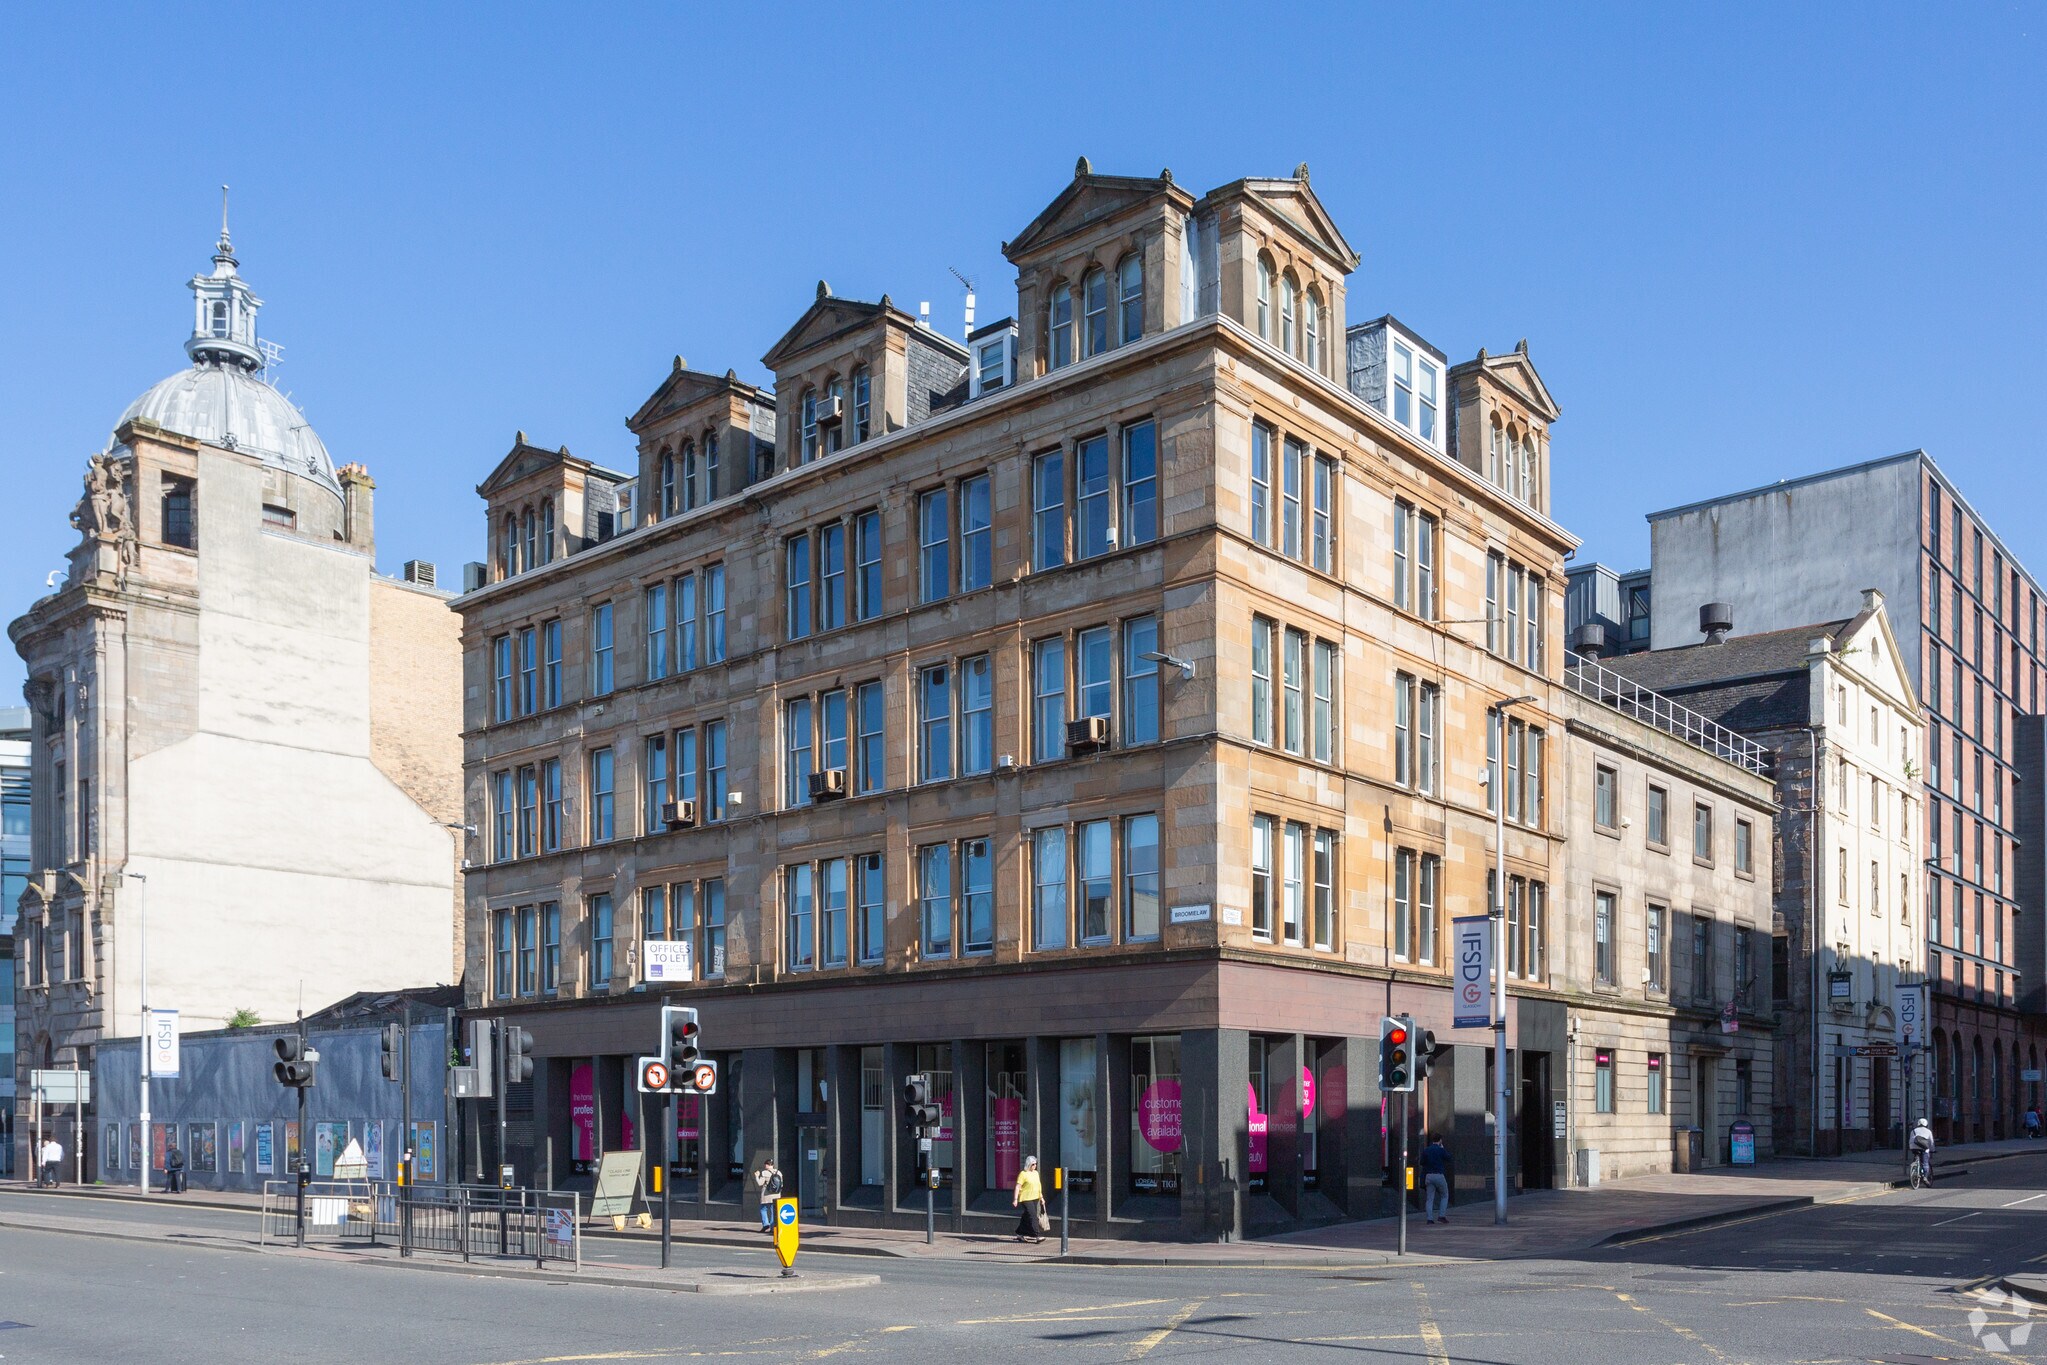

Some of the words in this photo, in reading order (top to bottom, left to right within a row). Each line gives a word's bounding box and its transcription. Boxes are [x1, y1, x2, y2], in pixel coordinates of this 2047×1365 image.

[1174, 910, 1208, 918] BROOMIELAW
[650, 944, 690, 954] OFFICES
[654, 953, 668, 963] TO
[670, 953, 687, 963] LET
[1462, 933, 1481, 982] IFSD
[1901, 993, 1915, 1022] IFSD
[158, 1019, 172, 1050] IFSD
